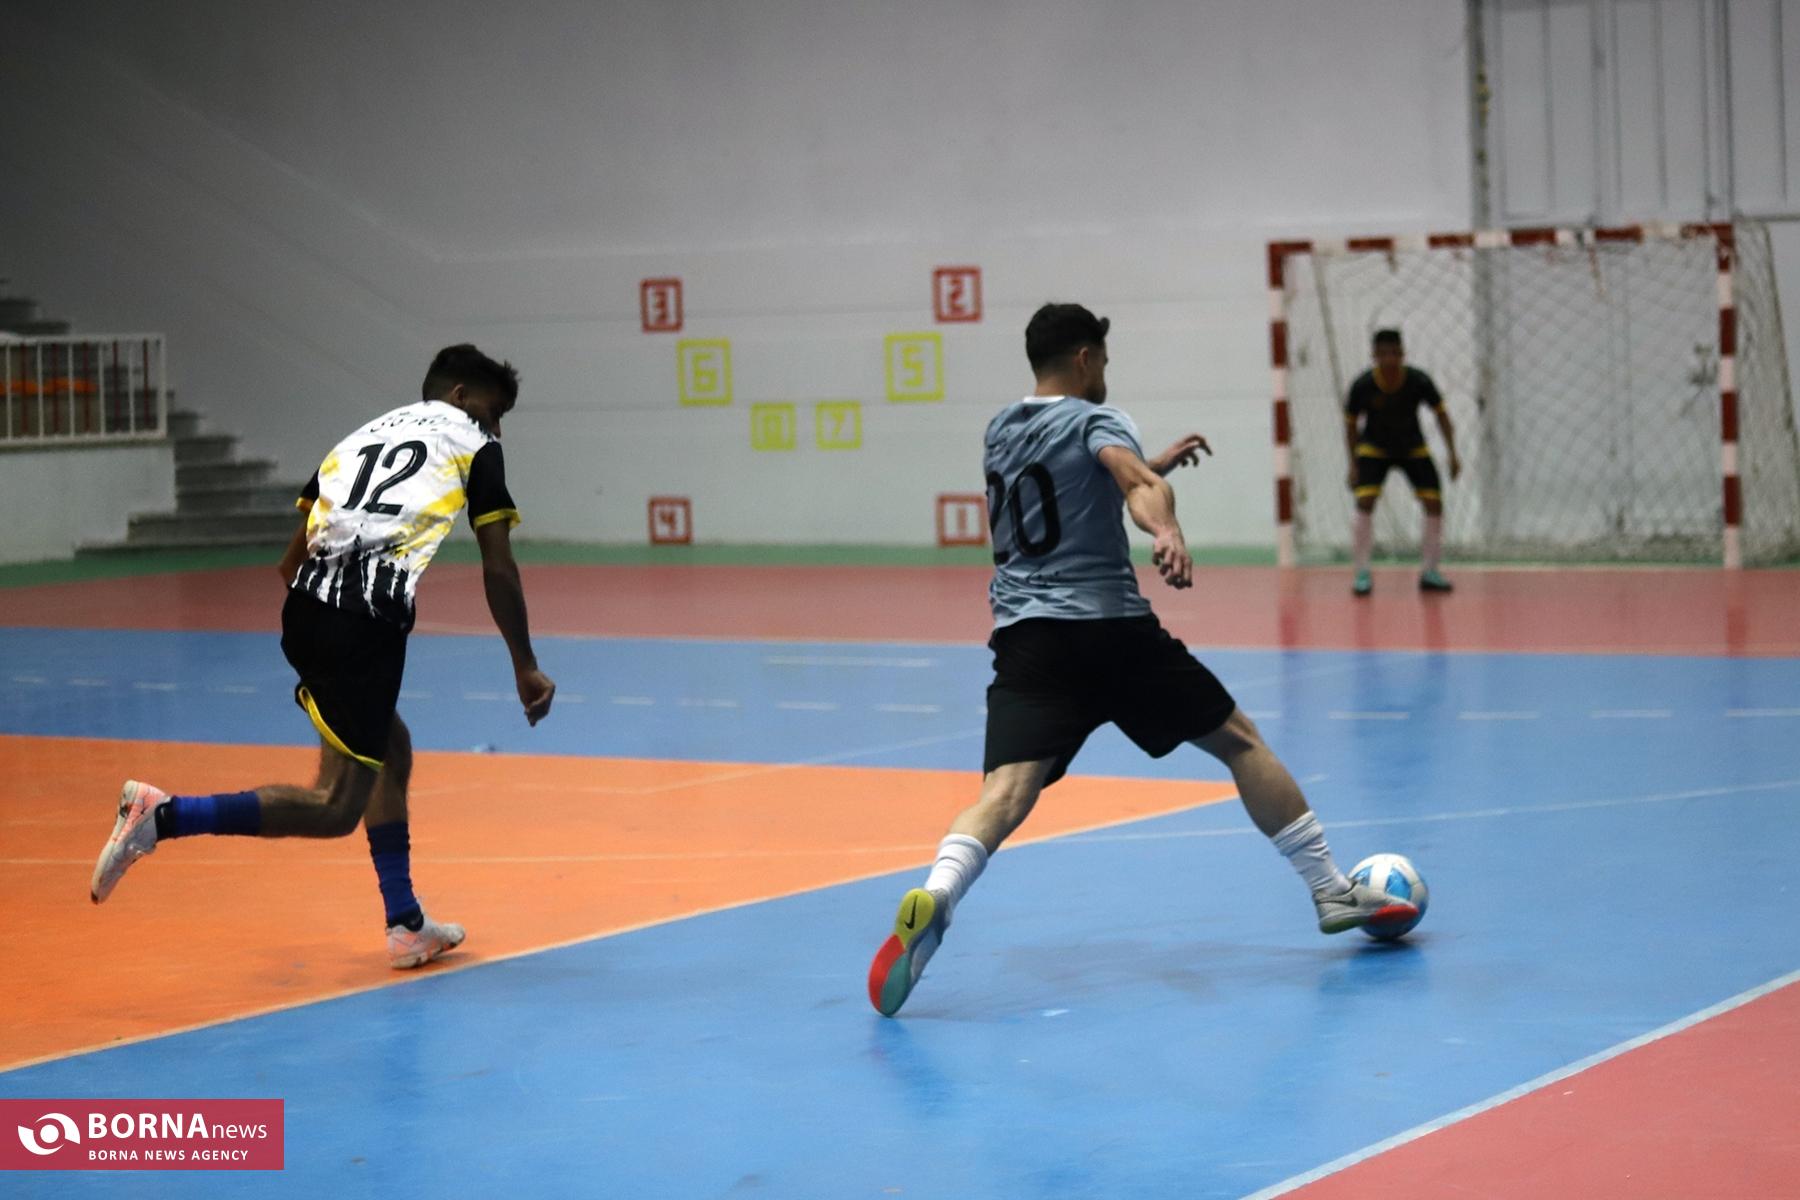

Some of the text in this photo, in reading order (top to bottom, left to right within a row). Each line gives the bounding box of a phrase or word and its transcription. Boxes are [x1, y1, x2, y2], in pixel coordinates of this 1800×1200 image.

[948, 276, 965, 317] 2
[692, 353, 718, 392] 6
[902, 345, 924, 387] 5
[341, 440, 428, 515] 12
